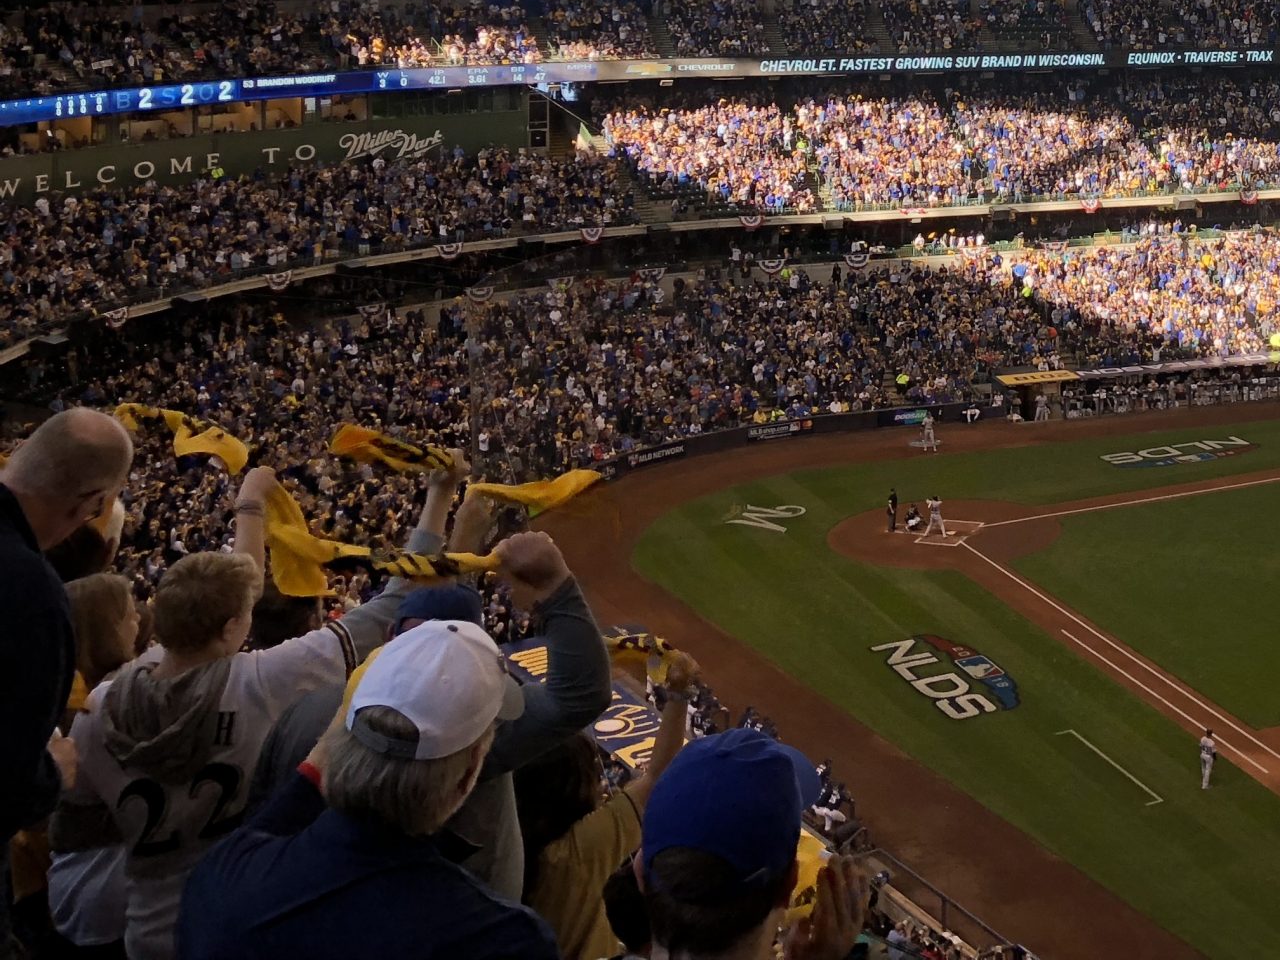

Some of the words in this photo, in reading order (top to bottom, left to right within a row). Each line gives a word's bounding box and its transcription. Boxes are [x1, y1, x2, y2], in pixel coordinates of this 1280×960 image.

[677, 63, 735, 71] CHEVROLET
[760, 59, 836, 73] CHEVROLET.
[838, 58, 893, 71] FASTEST
[895, 56, 952, 69] GROWING
[955, 56, 979, 68] SUV
[981, 55, 1021, 68] BRAND
[1023, 54, 1034, 67] IN
[1035, 53, 1106, 67] WISCONSIN.
[1127, 52, 1175, 64] EQUINOX
[1184, 51, 1237, 63] TRAVERSE
[1246, 50, 1273, 62] TRAX
[243, 80, 254, 89] 53
[257, 77, 294, 87] BRANDON
[295, 75, 335, 85] WOODRUFF
[380, 79, 386, 88] 3
[401, 77, 407, 87] 0
[429, 75, 445, 85] 42.1
[534, 72, 545, 81] 47
[116, 92, 130, 109] B
[138, 88, 152, 108] 2
[162, 90, 176, 105] S
[181, 85, 195, 104] 2
[219, 81, 232, 101] 2
[339, 130, 403, 160] Miller
[392, 130, 444, 161] Park
[0, 153, 220, 200] WELCOME
[262, 144, 316, 164] TO
[894, 411, 928, 421] DOOSAN
[653, 445, 684, 459] NETWORK
[1101, 436, 1250, 464] NLDS
[871, 639, 997, 720] NLDS
[116, 762, 249, 858] 22
